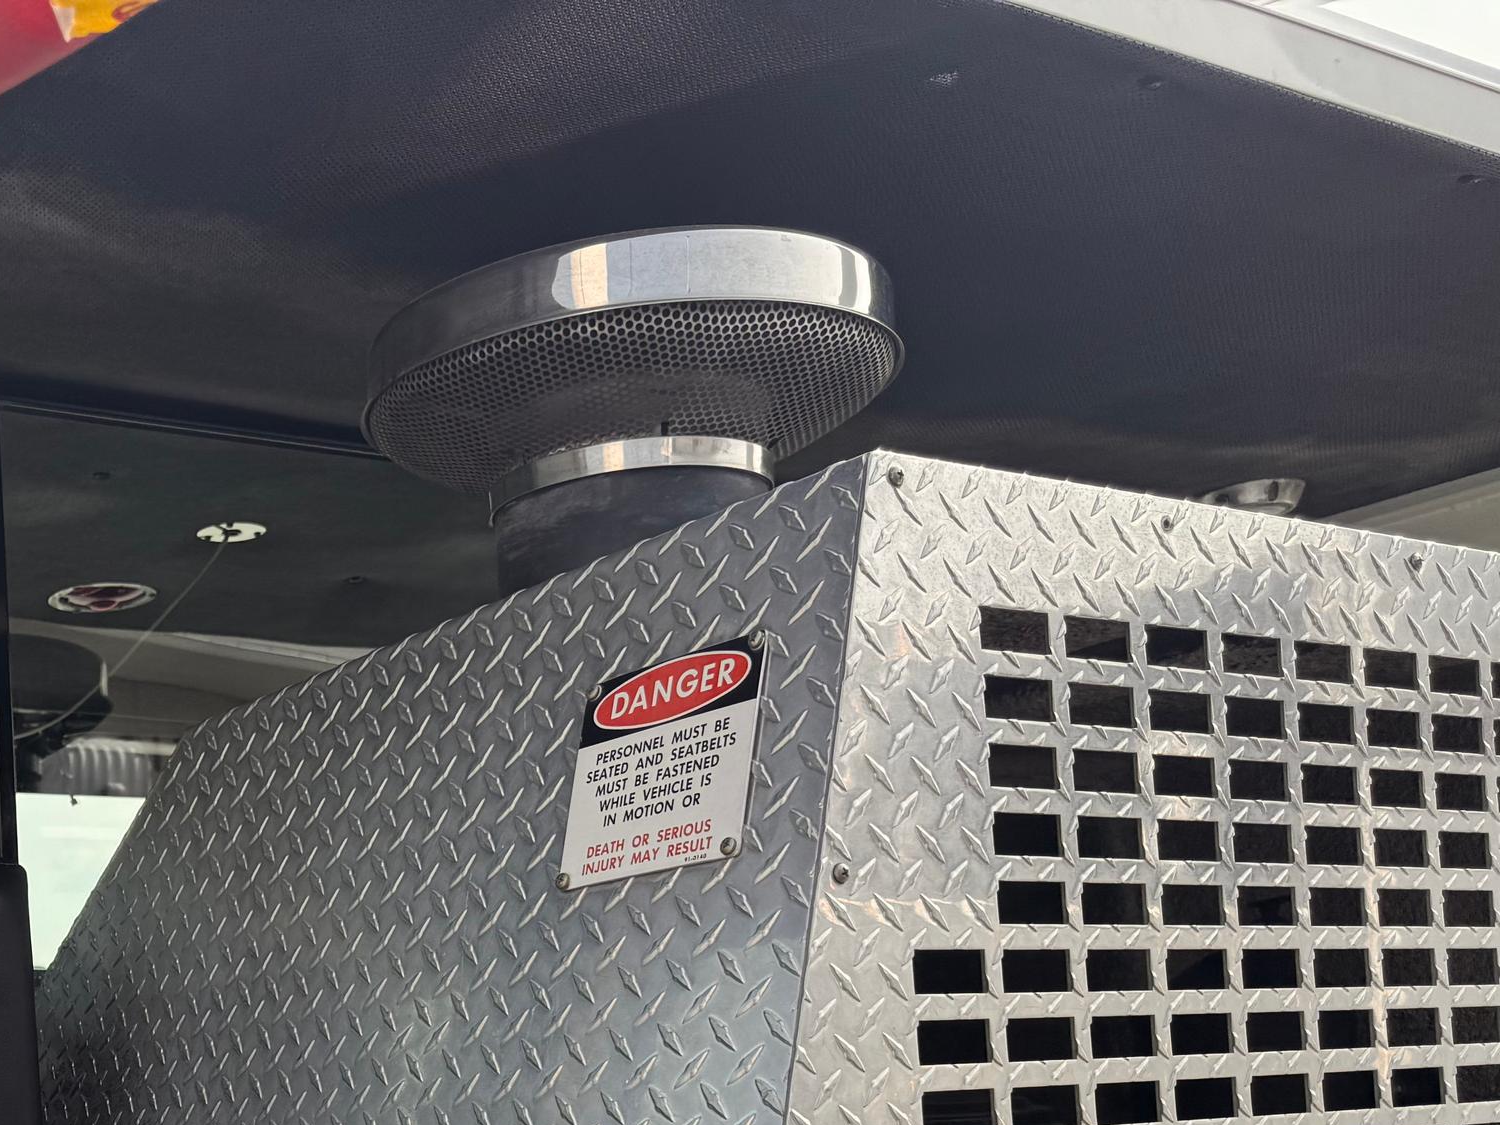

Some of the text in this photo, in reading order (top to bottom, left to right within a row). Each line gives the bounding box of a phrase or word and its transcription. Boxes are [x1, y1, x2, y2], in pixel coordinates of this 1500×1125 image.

[610, 657, 736, 720] DANGER
[586, 732, 737, 784] SEATED AND SEATBELTS
[596, 717, 730, 765] PERSONNEL MUST BE
[595, 753, 720, 798] MUST BE FASTENED
[599, 773, 712, 812] WHILE VEHICLE IS
[603, 792, 701, 828] IN MOTION OR
[581, 836, 713, 876] INJURY MAY RESULT
[586, 819, 712, 859] DEATH OR SERIOUS
